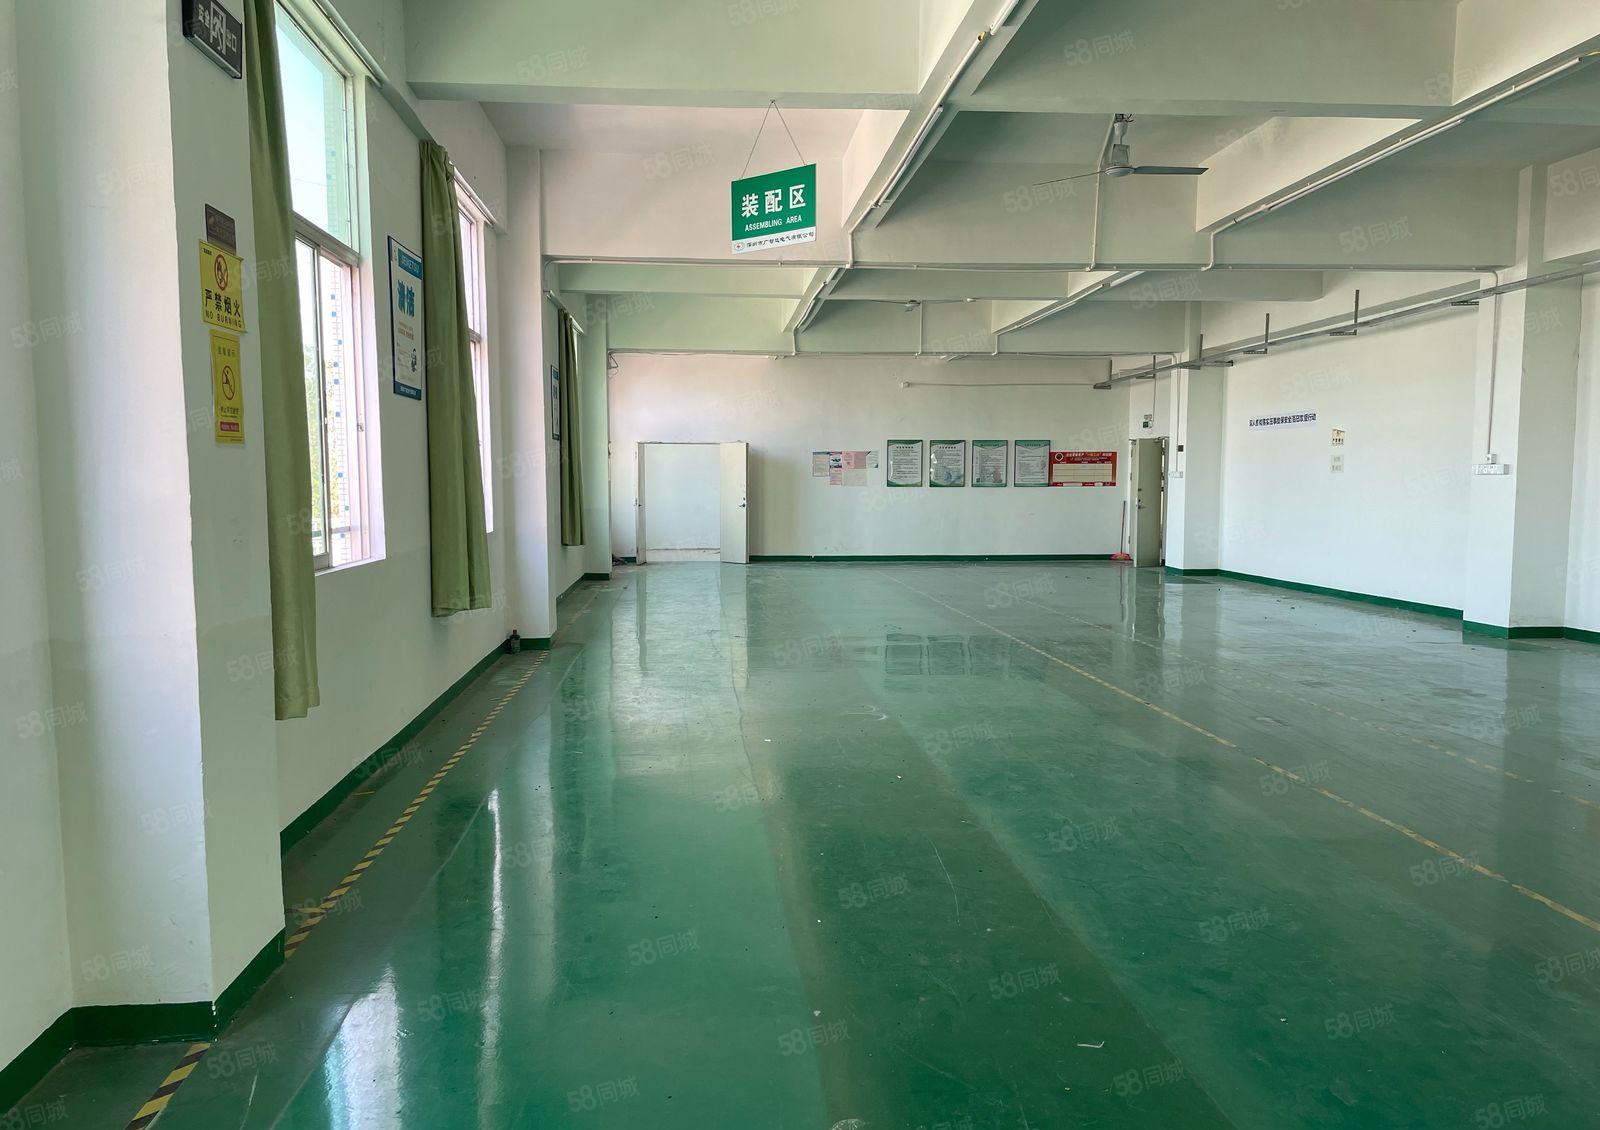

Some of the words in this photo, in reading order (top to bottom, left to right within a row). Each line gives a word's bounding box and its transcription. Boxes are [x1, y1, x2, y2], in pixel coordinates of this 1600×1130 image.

[741, 184, 806, 218] 装配区
[745, 219, 782, 232] ASSEMBLING
[786, 215, 802, 224] AREA
[204, 288, 241, 318] 严禁烟火
[205, 309, 214, 320] NO
[217, 313, 242, 328] BURNING
